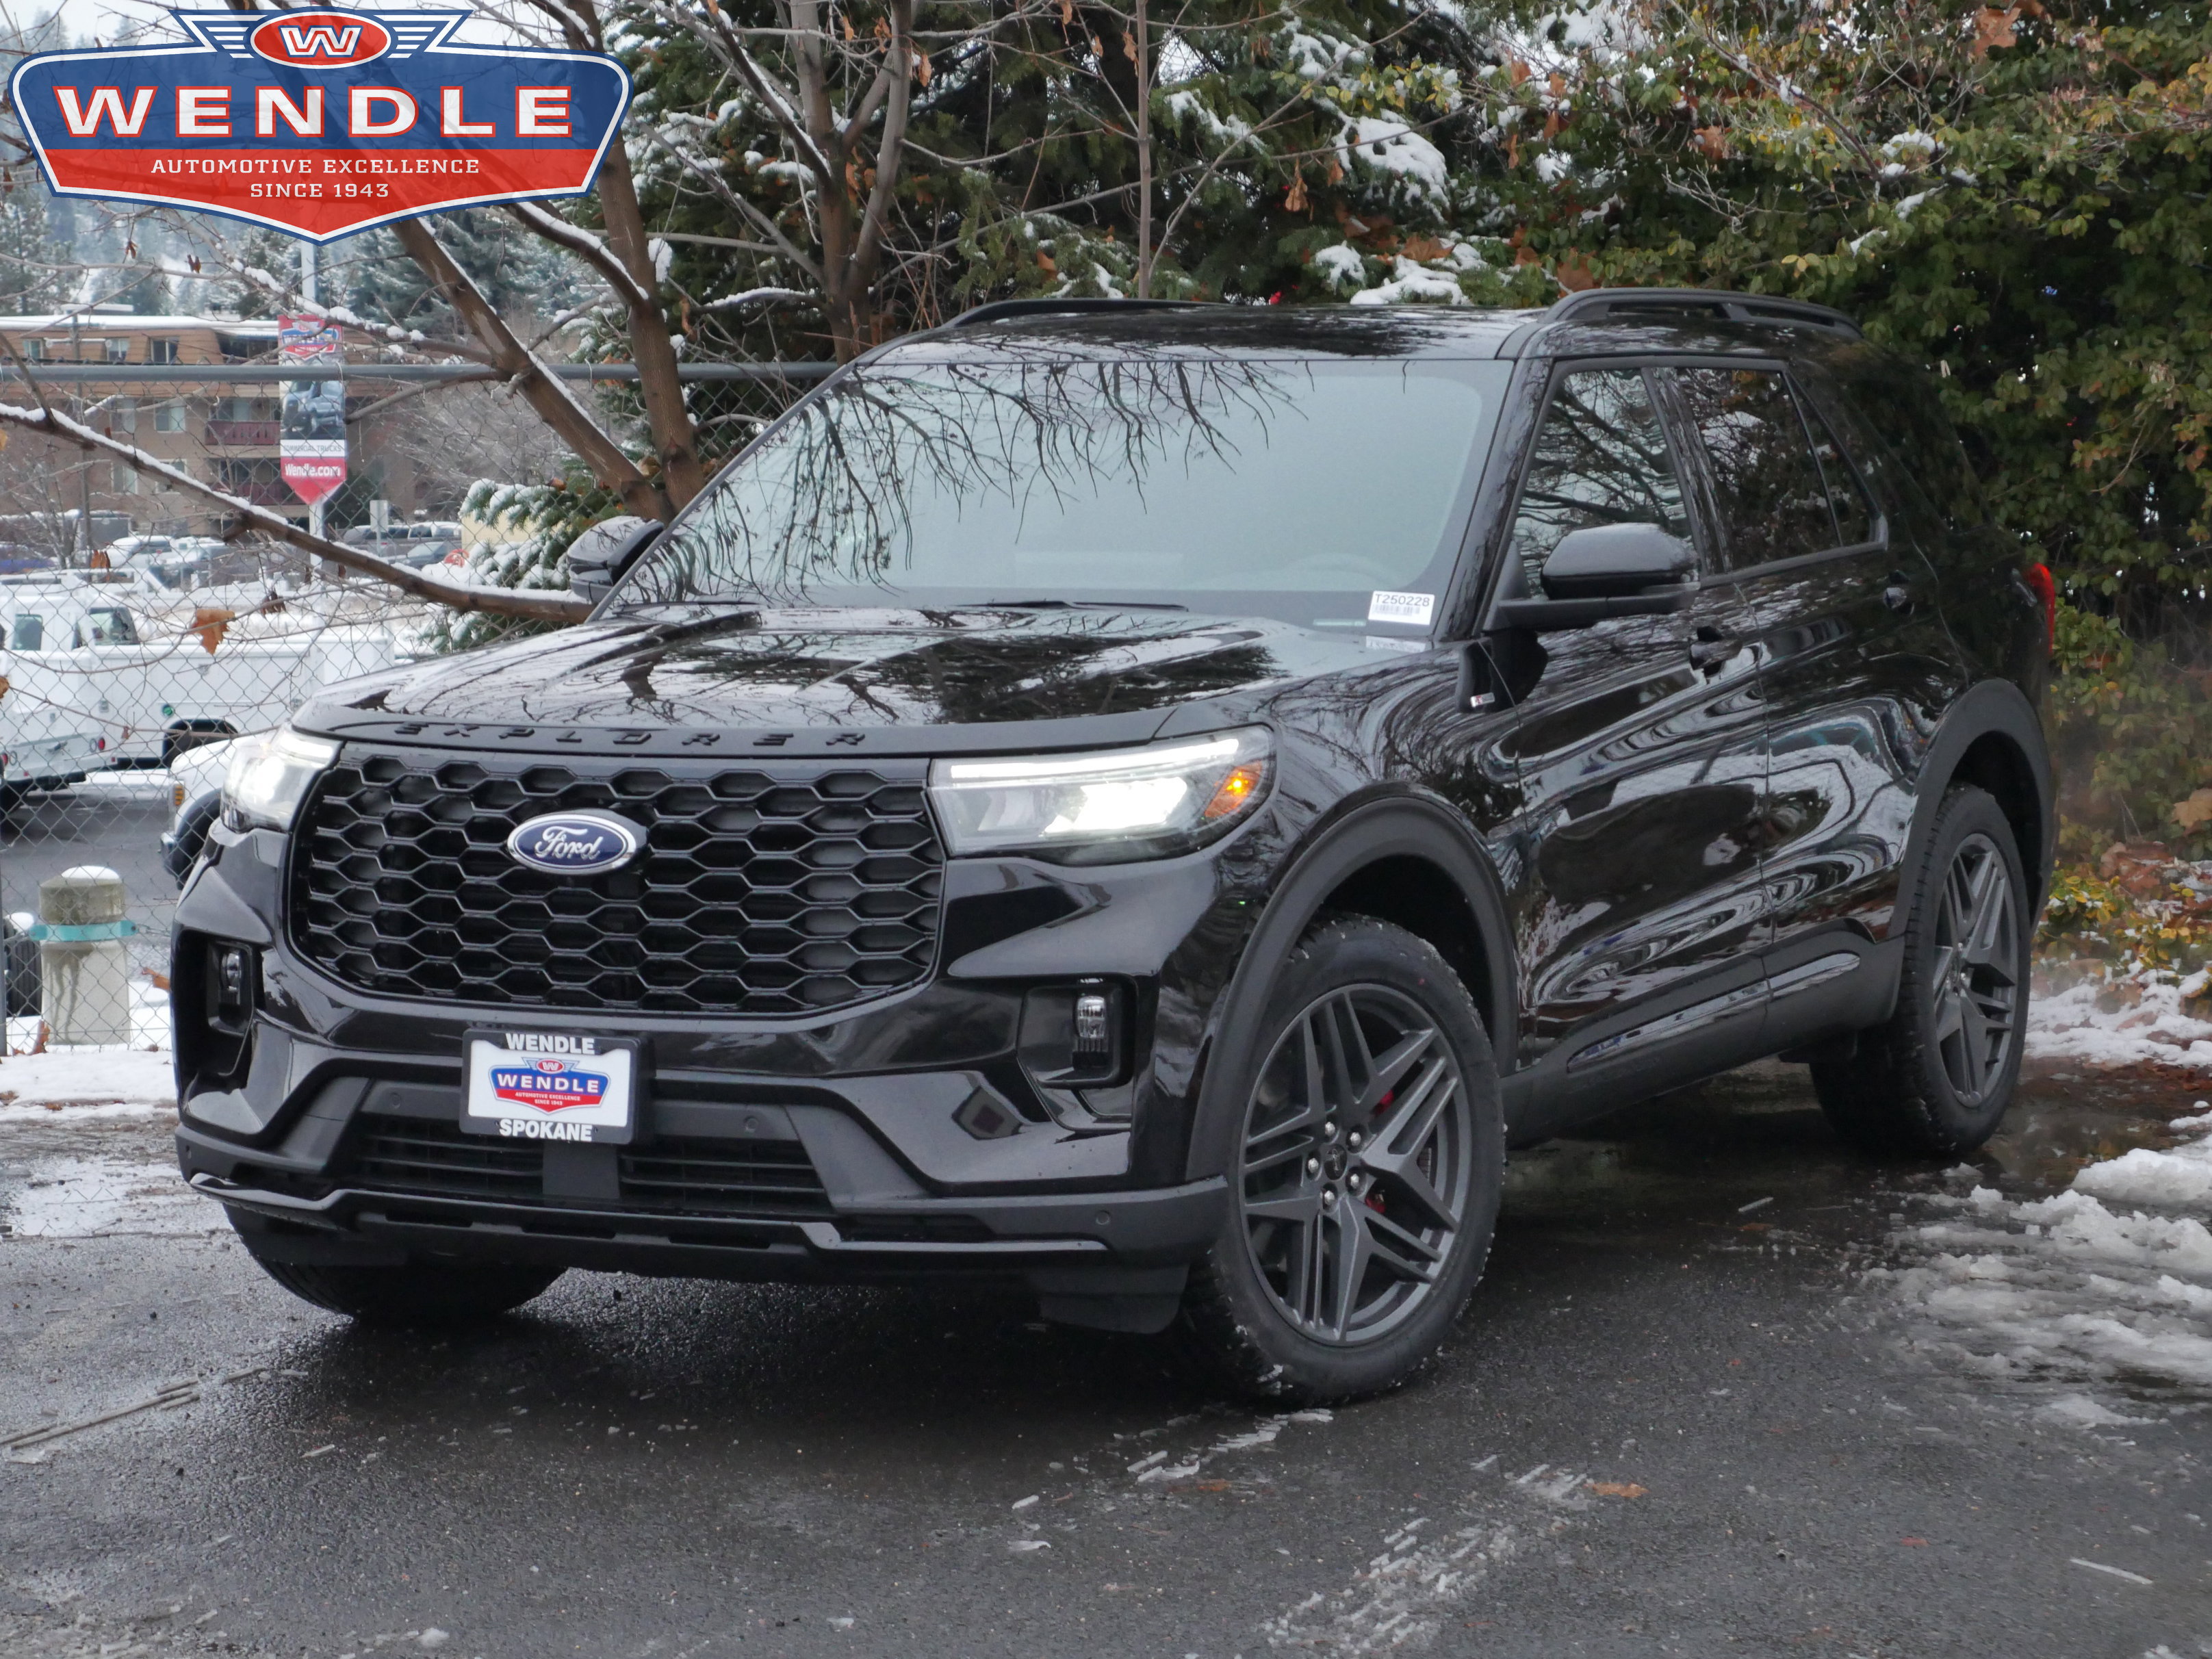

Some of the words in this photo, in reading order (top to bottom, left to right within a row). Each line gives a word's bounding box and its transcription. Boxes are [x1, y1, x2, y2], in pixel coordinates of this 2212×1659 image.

[284, 463, 342, 477] Wendle.com
[1375, 593, 1430, 606] T250228
[394, 720, 865, 747] EXPLORER
[535, 825, 604, 861] Ford
[505, 1033, 595, 1055] WENDLE
[542, 1062, 559, 1071] W
[496, 1073, 599, 1093] WENDLE
[499, 1119, 593, 1142] SPOKANE
